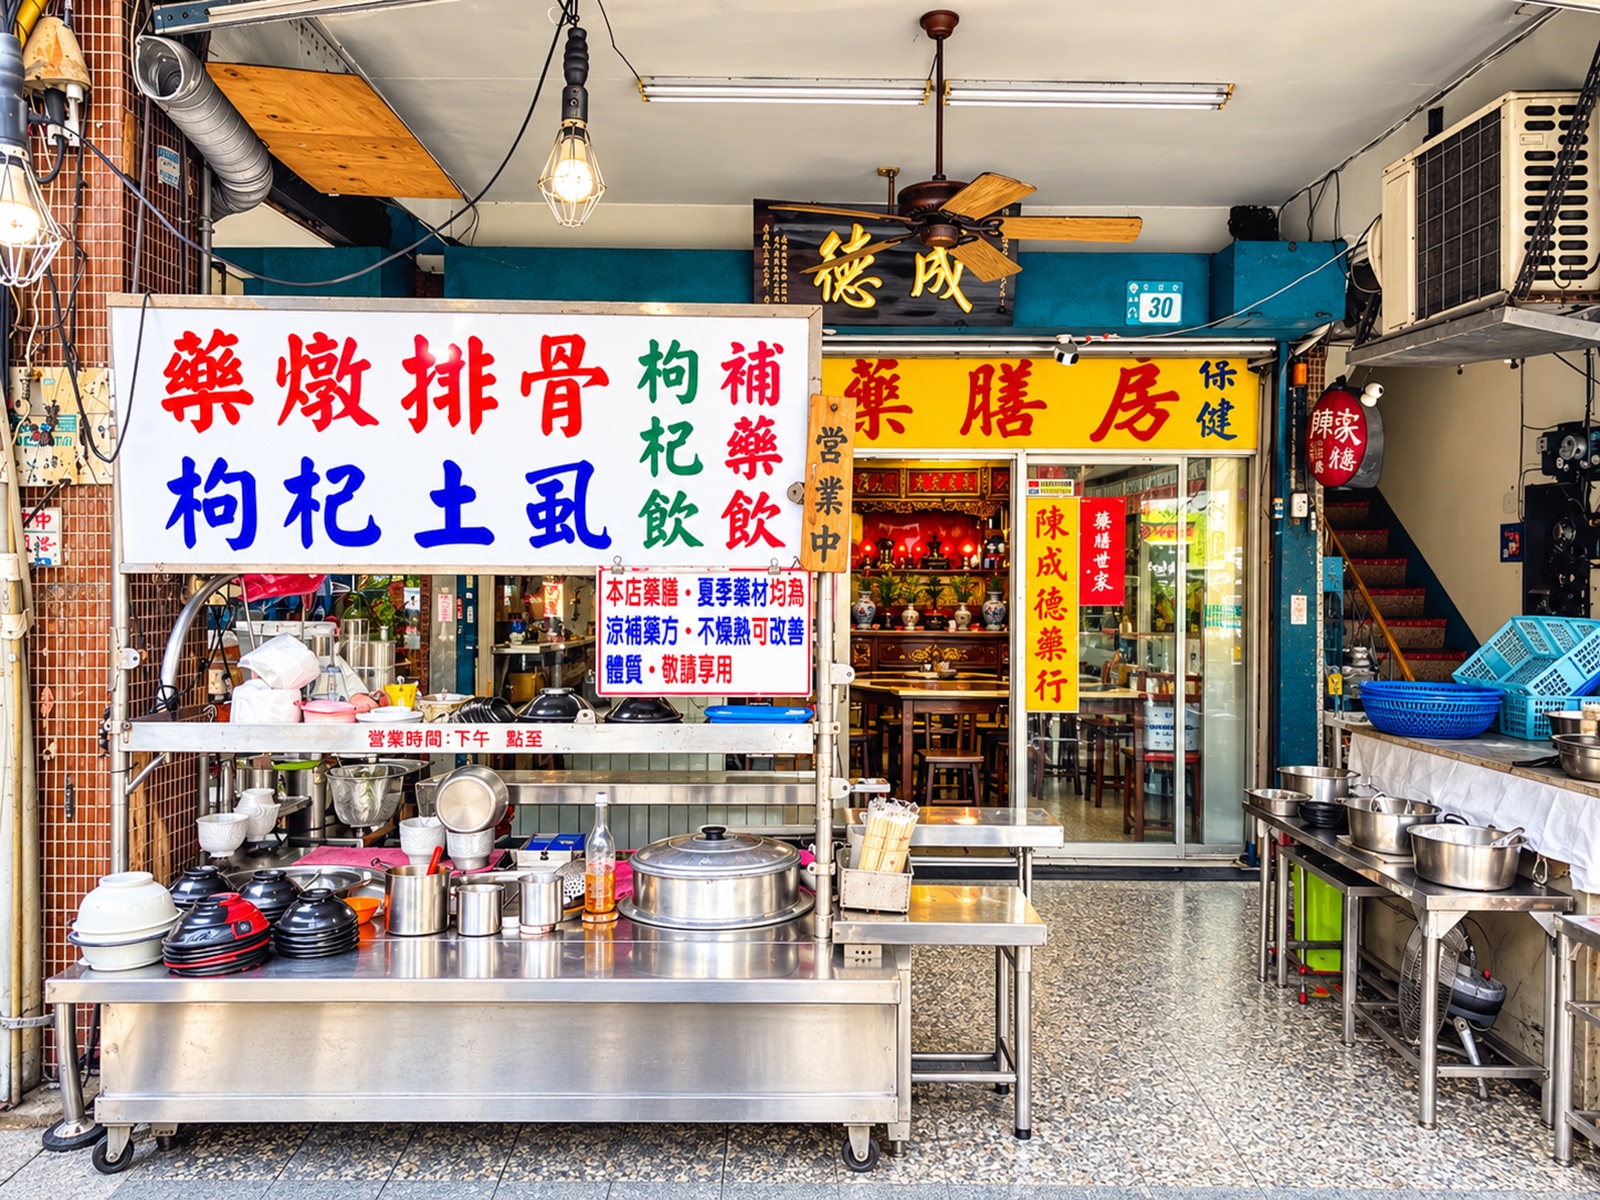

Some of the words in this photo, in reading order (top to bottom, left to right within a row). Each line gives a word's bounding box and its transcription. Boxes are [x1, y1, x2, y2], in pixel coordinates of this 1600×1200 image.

[1148, 296, 1174, 319] 30
[161, 328, 610, 438] 藥燉排骨
[844, 356, 1180, 442] 藥膳房
[1196, 359, 1238, 441] 保健
[638, 338, 704, 549] 枸杞飲
[720, 340, 786, 550] 補藥飲
[165, 455, 612, 552] 枸杞土虱
[1091, 510, 1114, 592] 藥膳世家
[1033, 504, 1070, 704] 陳成德藥行
[506, 730, 543, 748] 點至
